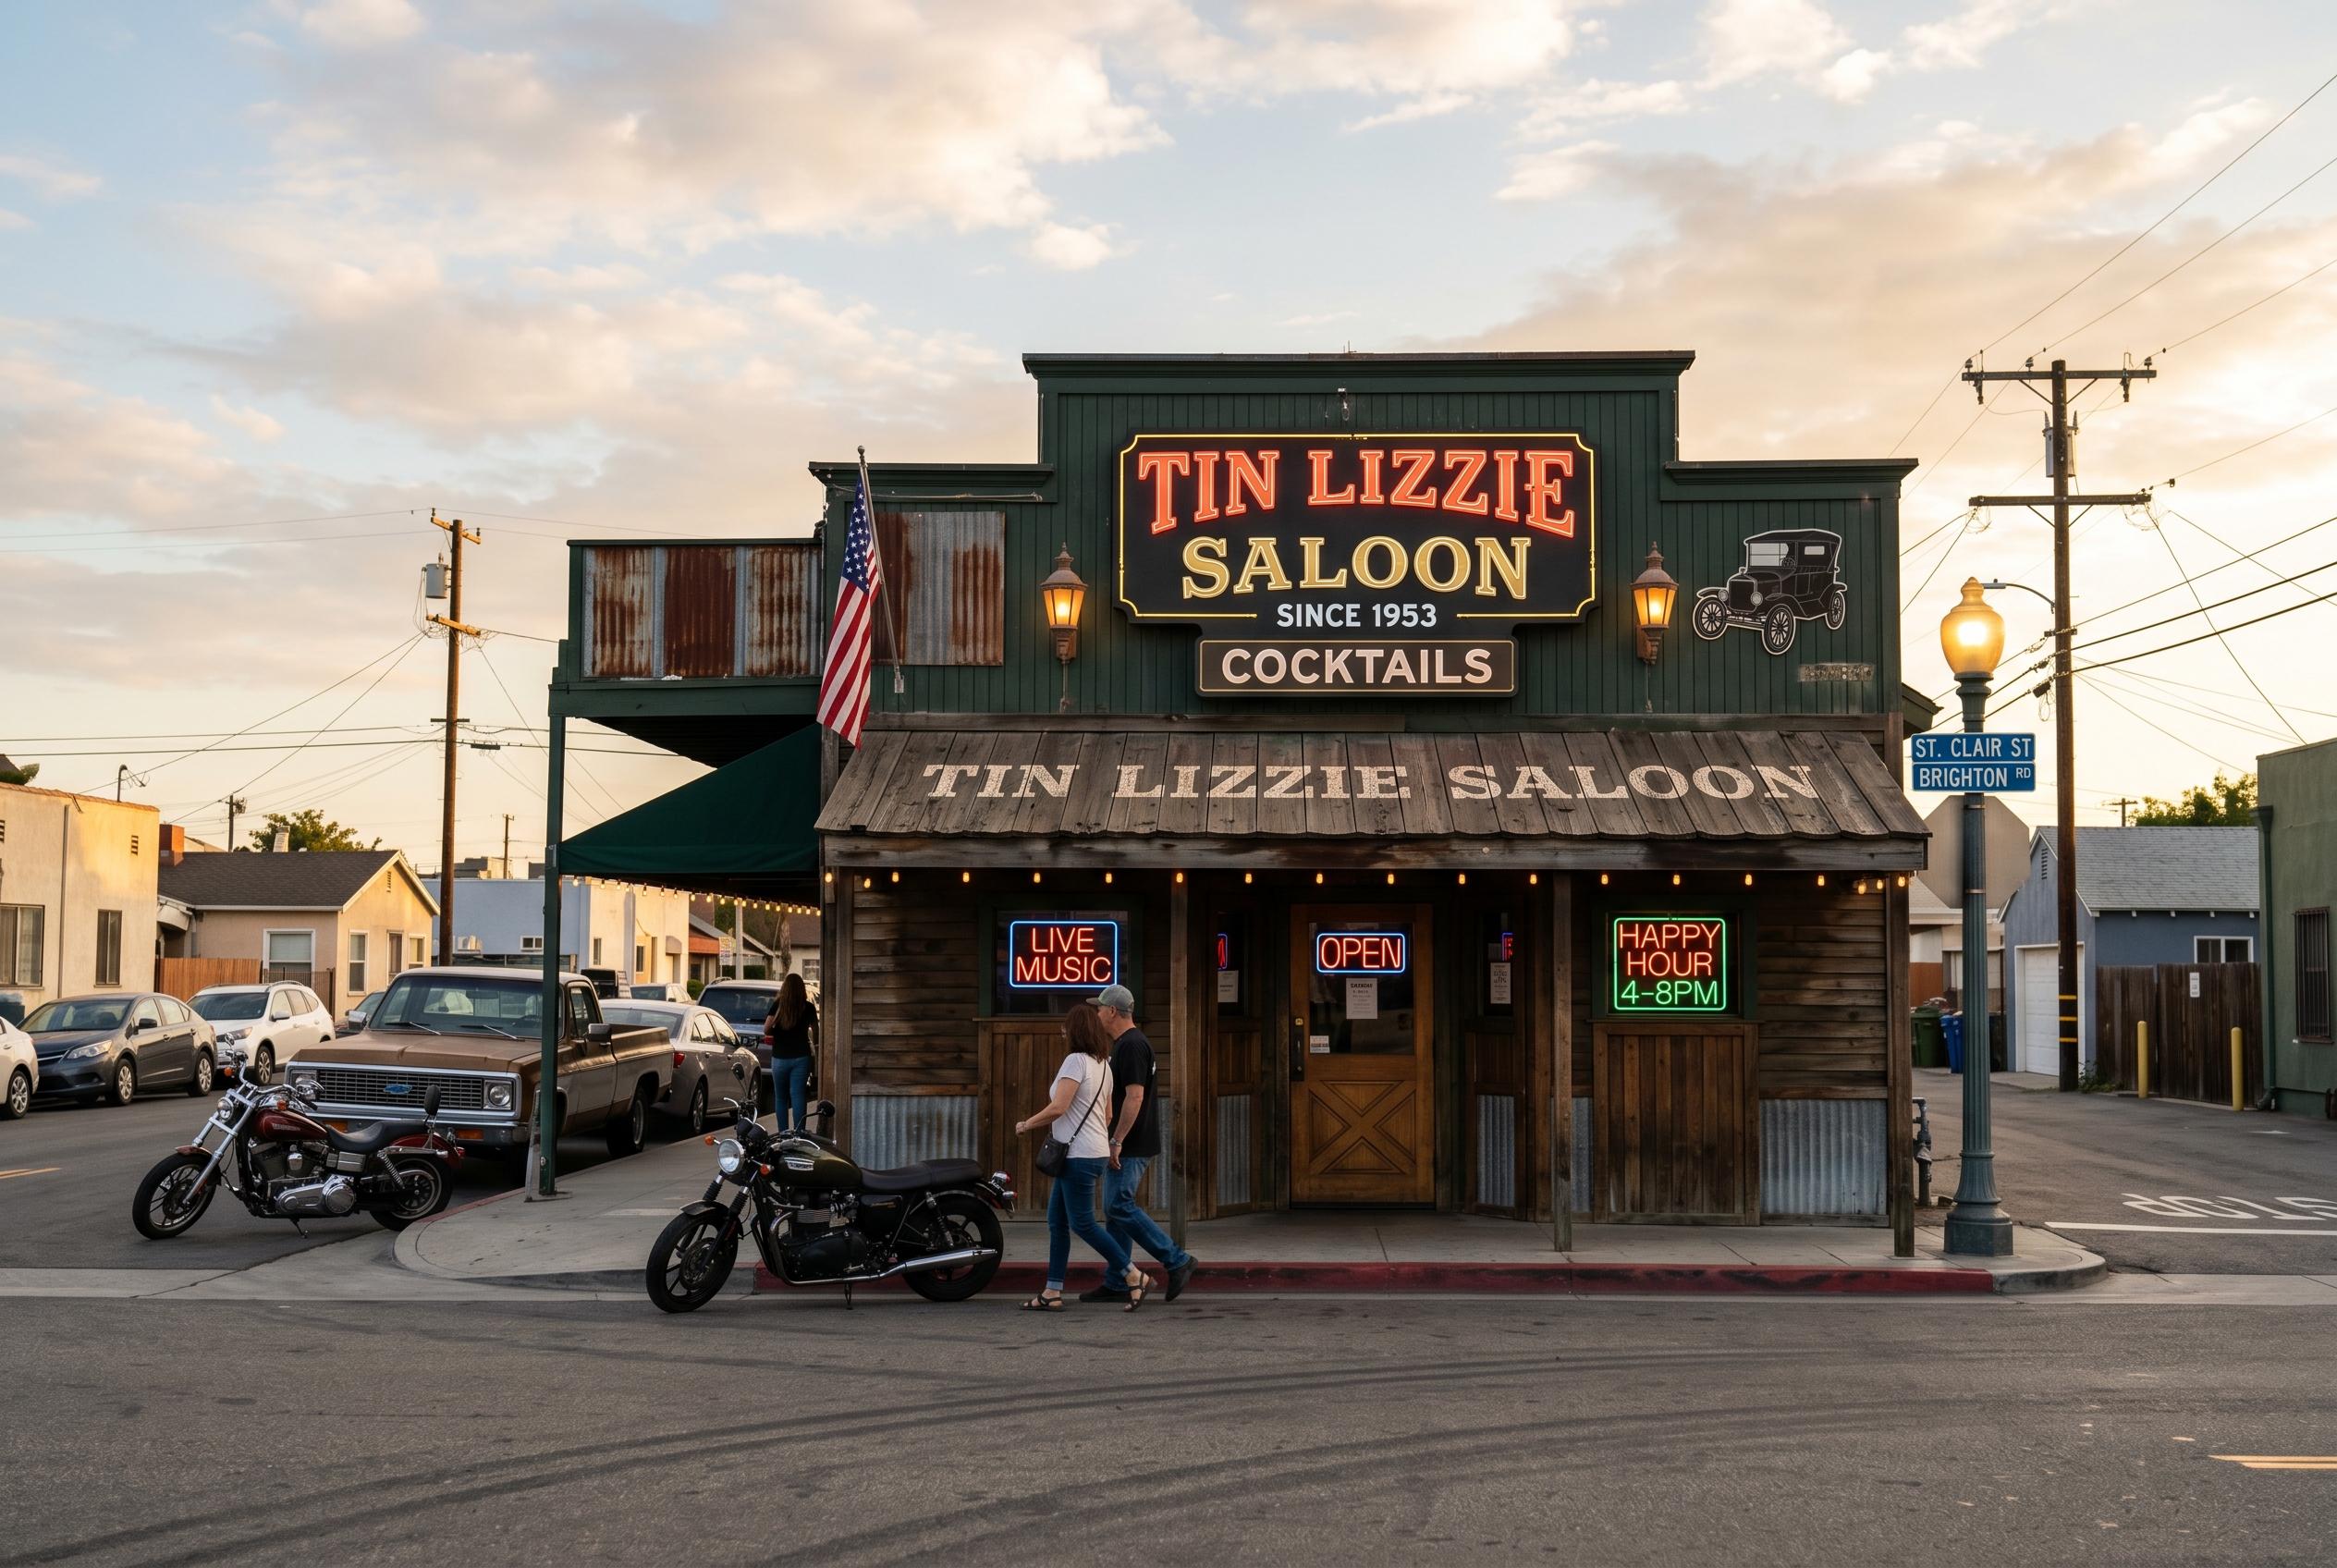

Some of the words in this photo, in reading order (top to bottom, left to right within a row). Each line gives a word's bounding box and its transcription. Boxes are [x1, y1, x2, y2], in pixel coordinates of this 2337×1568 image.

[1138, 449, 1280, 534] TIN
[1307, 449, 1575, 538] LIZZIE
[1181, 535, 1532, 600] SALOON
[1277, 603, 1361, 628] SINCE
[1372, 603, 1438, 628] 1953
[1221, 648, 1493, 684] COCKTAILS
[1915, 738, 1941, 758] ST.
[1951, 738, 2002, 757] CLAIR
[2011, 737, 2032, 757] ST
[923, 764, 1081, 799] TIN
[1112, 765, 1411, 799] LIZZIE
[1448, 765, 1819, 800] SALOON
[1919, 766, 2008, 788] BRIGHTON
[2016, 767, 2031, 778] RD
[1031, 927, 1095, 953] LIVE
[1620, 924, 1720, 949] HAPPY
[1320, 937, 1401, 969] OPEN
[1627, 950, 1713, 977] HOUR
[1016, 955, 1112, 983] MUSIC
[1621, 980, 1719, 1005] 4-8PM
